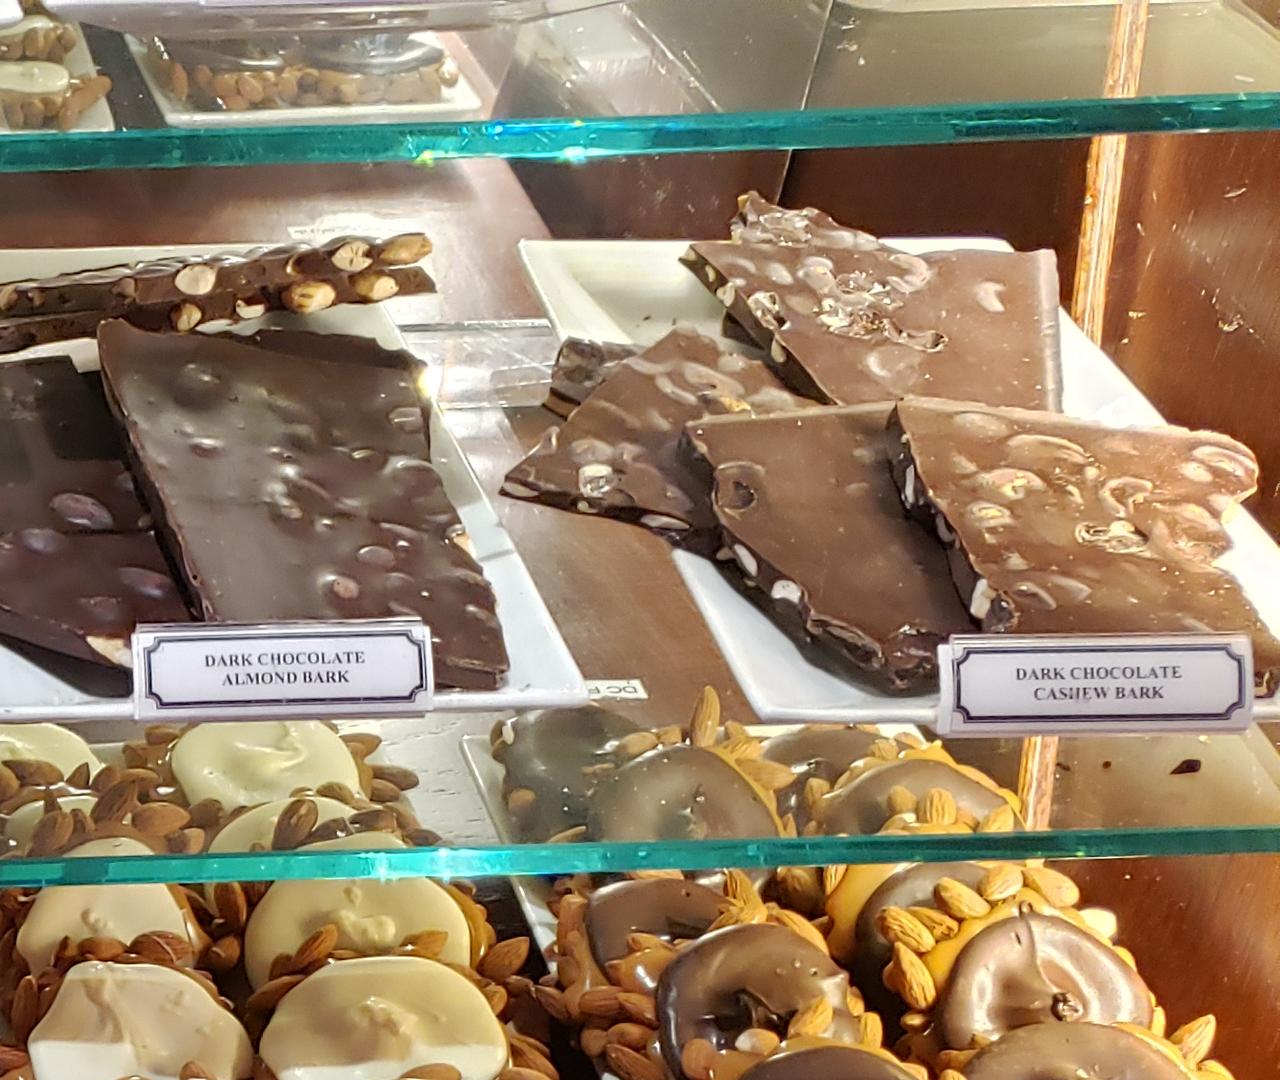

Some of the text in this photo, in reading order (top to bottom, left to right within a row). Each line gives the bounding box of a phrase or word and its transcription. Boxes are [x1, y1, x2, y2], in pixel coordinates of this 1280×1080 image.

[205, 651, 365, 667] DARK CHOCOLATE
[223, 670, 349, 686] ALMOND BARK
[1017, 666, 1182, 680] DARK CHOCOLATE
[1034, 687, 1164, 702] CASHEW BARK
